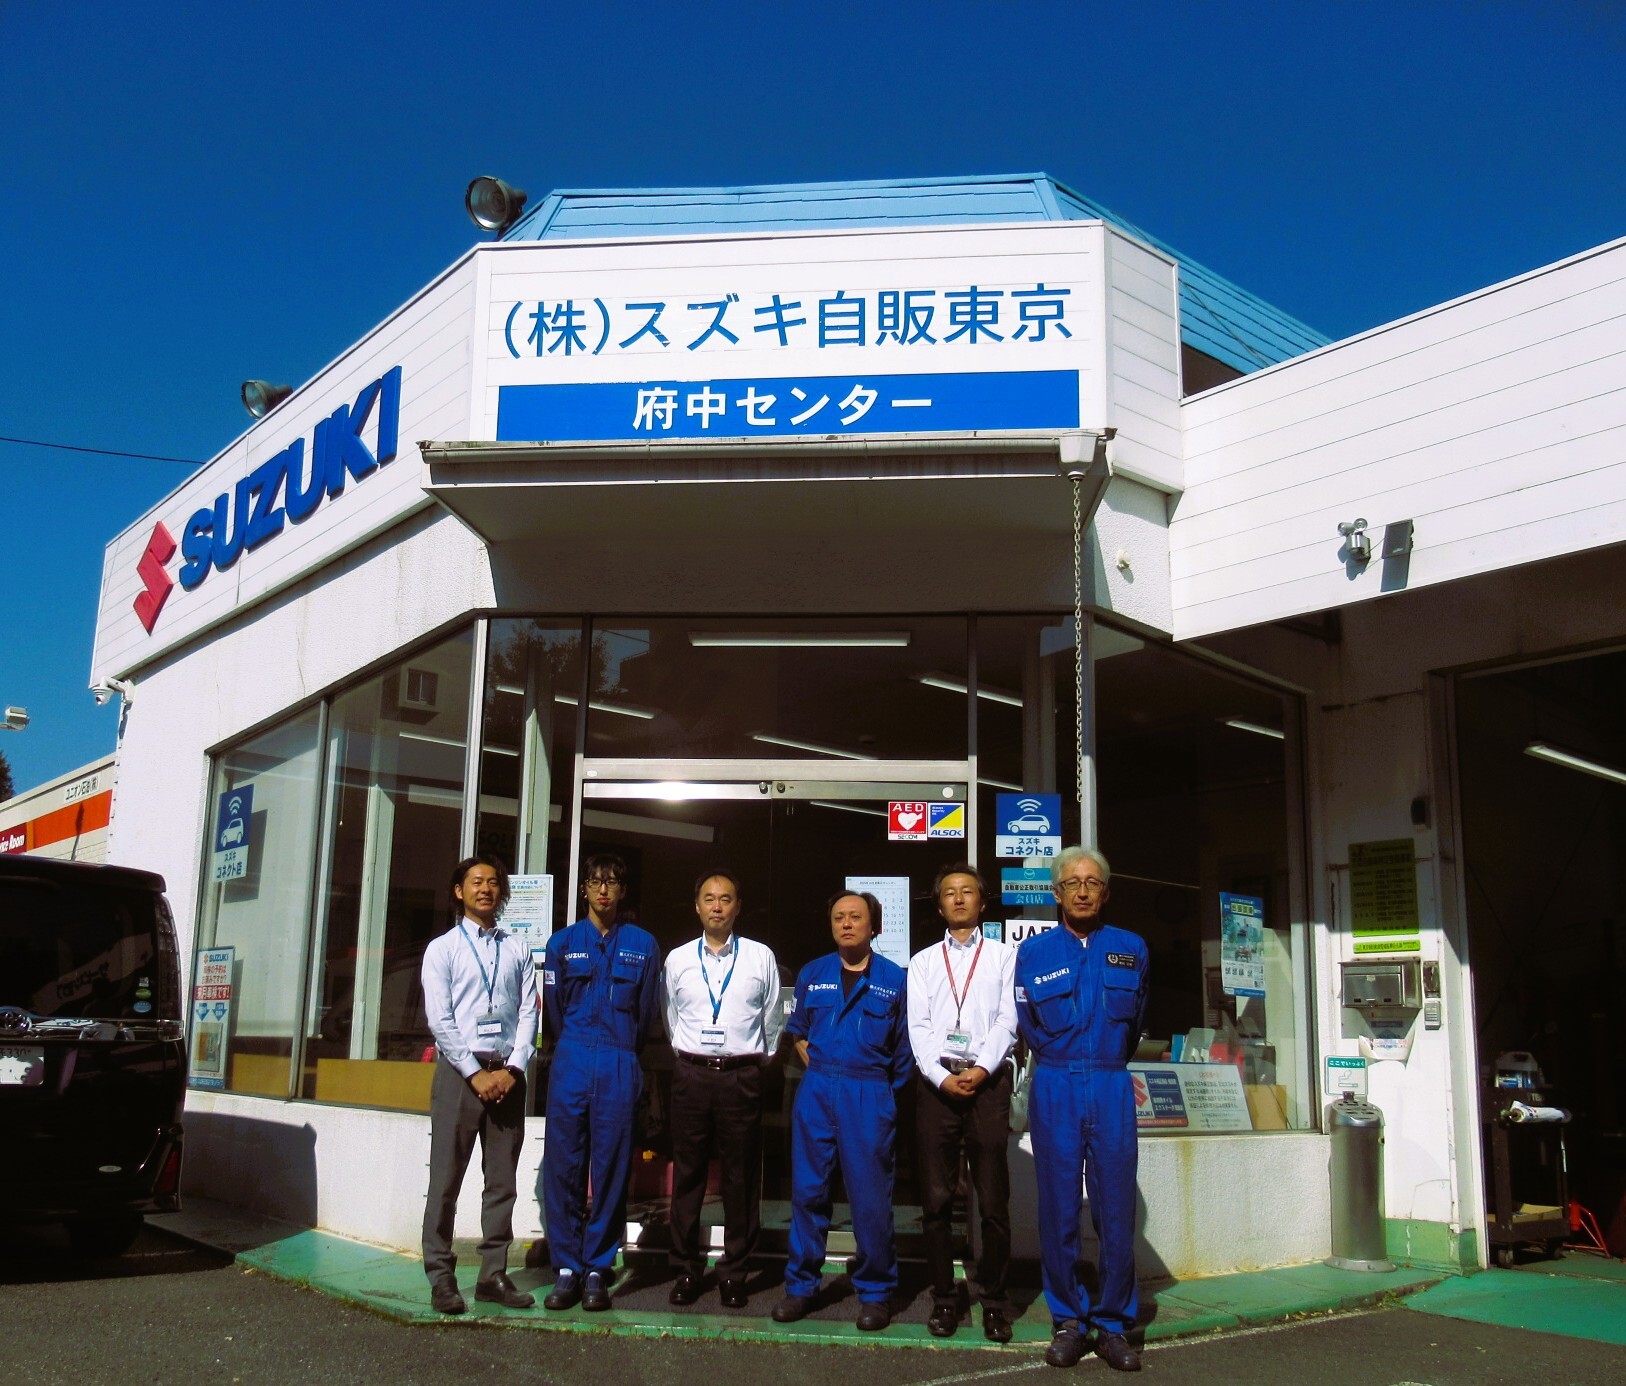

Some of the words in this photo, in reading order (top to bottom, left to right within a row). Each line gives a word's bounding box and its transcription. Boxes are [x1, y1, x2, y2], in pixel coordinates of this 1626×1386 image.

[504, 282, 1073, 360] (株)スズキ自販東京
[632, 384, 933, 430] 府中センター
[179, 365, 402, 592] SUZUKI
[892, 803, 924, 812] AED
[930, 829, 962, 837] ALSOK
[9, 834, 25, 850] Room
[1018, 837, 1040, 845] スズキ
[224, 851, 237, 861] スズキ
[1005, 846, 1053, 856] コネクト店
[216, 862, 242, 879] コネクト店
[1015, 894, 1043, 904] 会員店
[209, 953, 229, 962] SUZUKI
[1042, 967, 1070, 982] SUZUKI
[815, 983, 838, 991] SUZUKI
